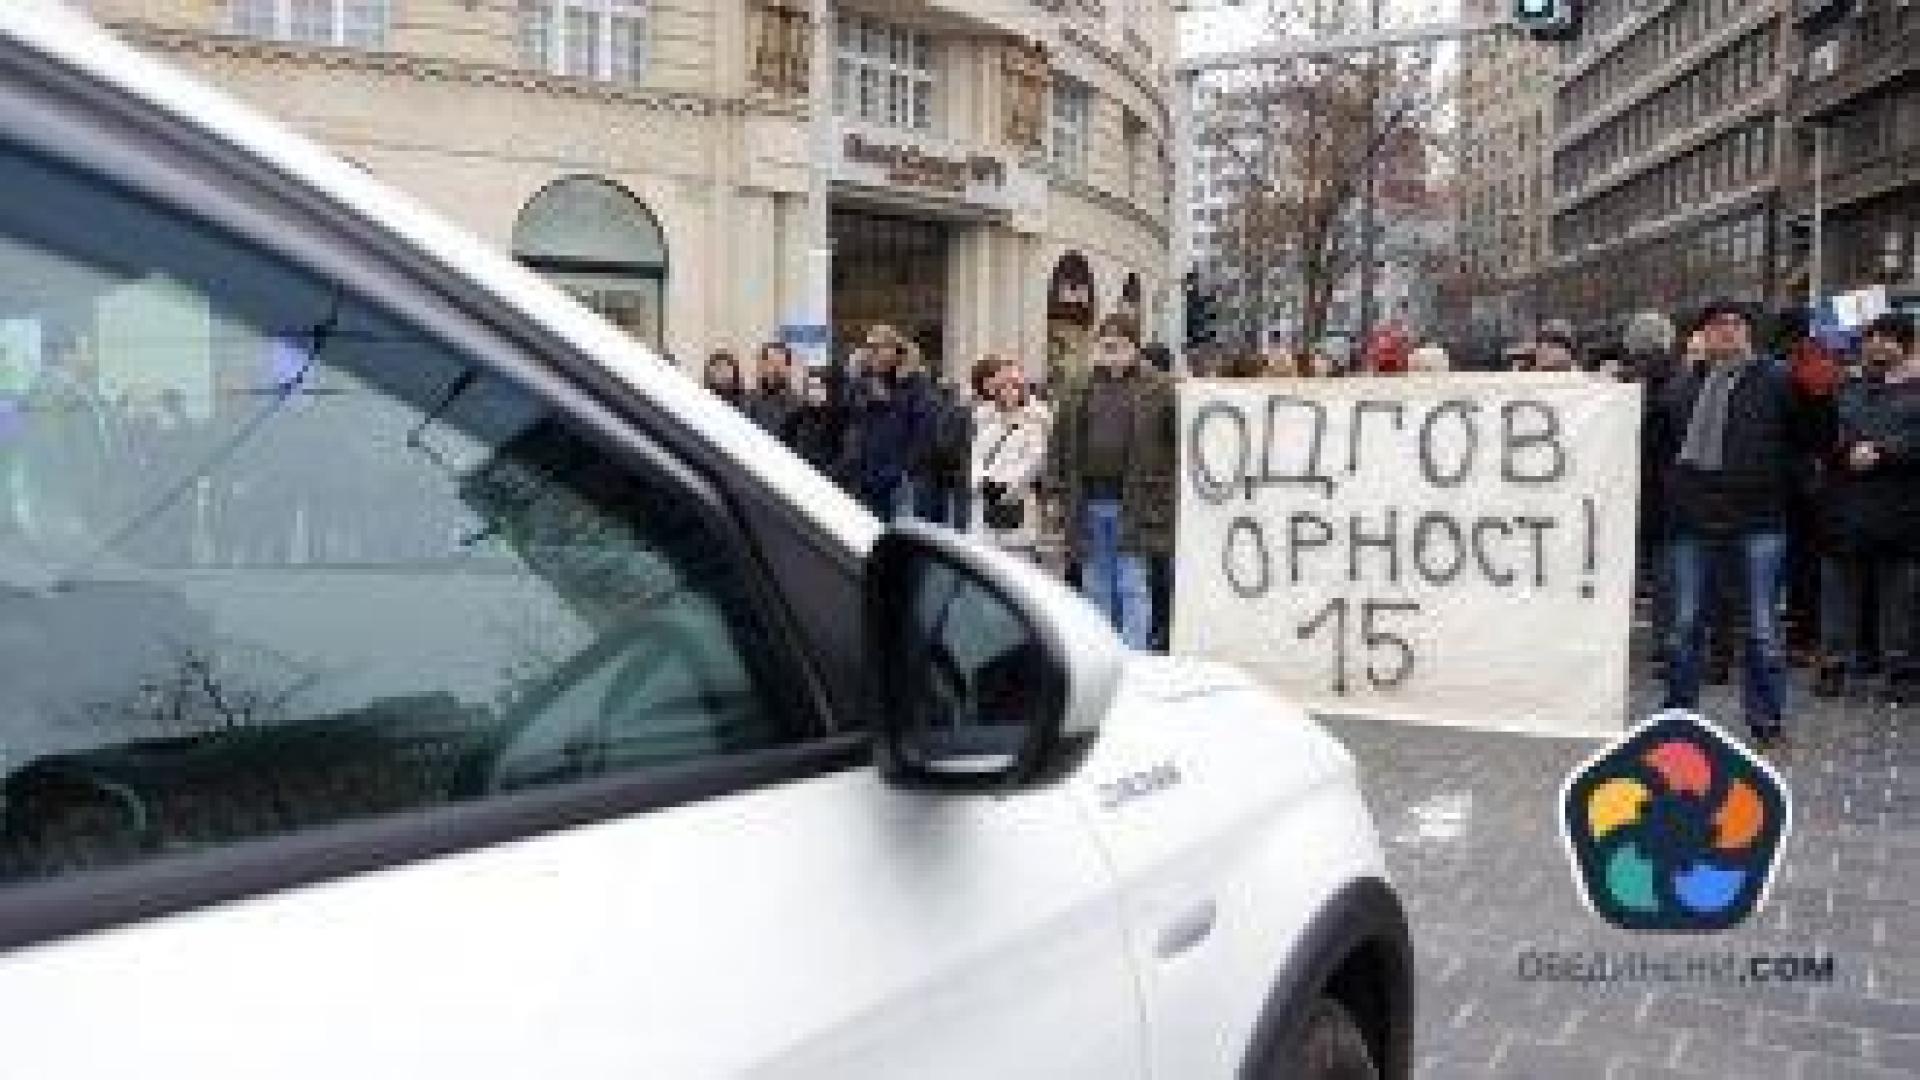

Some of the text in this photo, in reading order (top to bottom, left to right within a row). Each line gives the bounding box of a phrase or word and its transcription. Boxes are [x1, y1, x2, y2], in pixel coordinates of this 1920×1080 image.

[1190, 395, 1566, 505] ОДГОВ
[1222, 498, 1595, 599] ОРНОСТ!
[1298, 597, 1420, 696] 15
